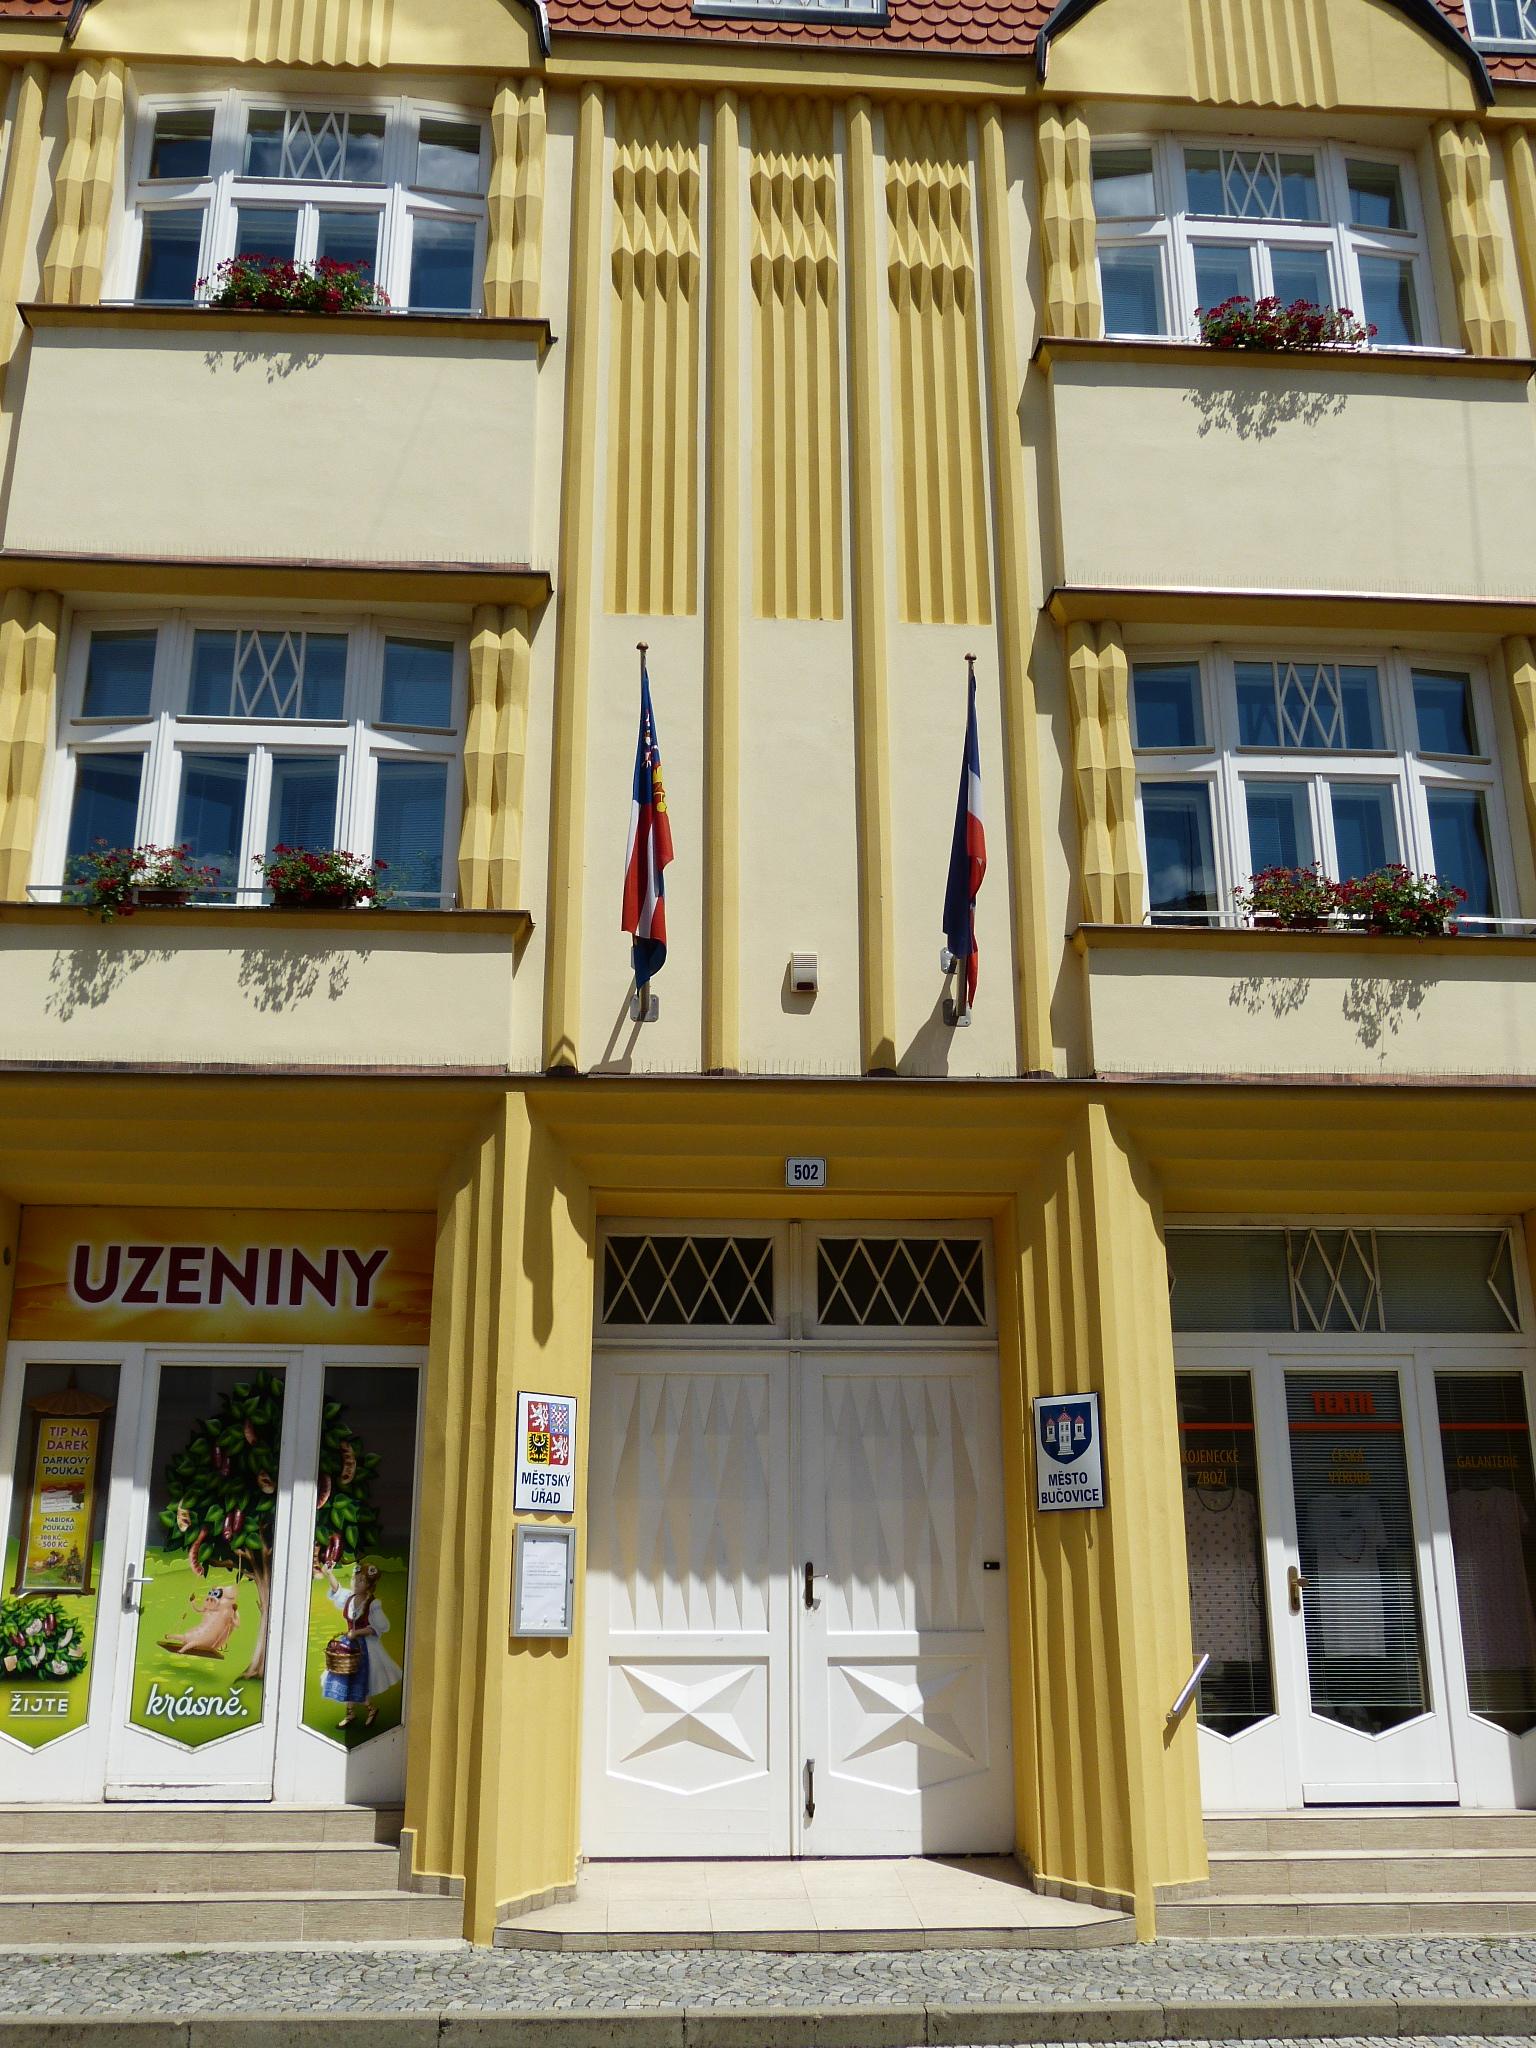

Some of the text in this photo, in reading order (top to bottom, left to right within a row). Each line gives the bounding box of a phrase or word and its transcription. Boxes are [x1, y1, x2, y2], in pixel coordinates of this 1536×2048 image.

[794, 1164, 818, 1180] 502
[73, 1245, 389, 1307] UZENINY
[1311, 1391, 1377, 1415] TEXTIL
[49, 1426, 89, 1437] TIP NA
[1456, 1455, 1519, 1470] GALANTERIE
[521, 1469, 571, 1487] MĚSTSKÝ
[1048, 1470, 1088, 1487] MĚSTO
[531, 1487, 561, 1504] ÚŘAD
[1041, 1488, 1100, 1504] BUČOVICE
[10, 1695, 68, 1712] ŽIJTE
[146, 1684, 248, 1721] krásně.
